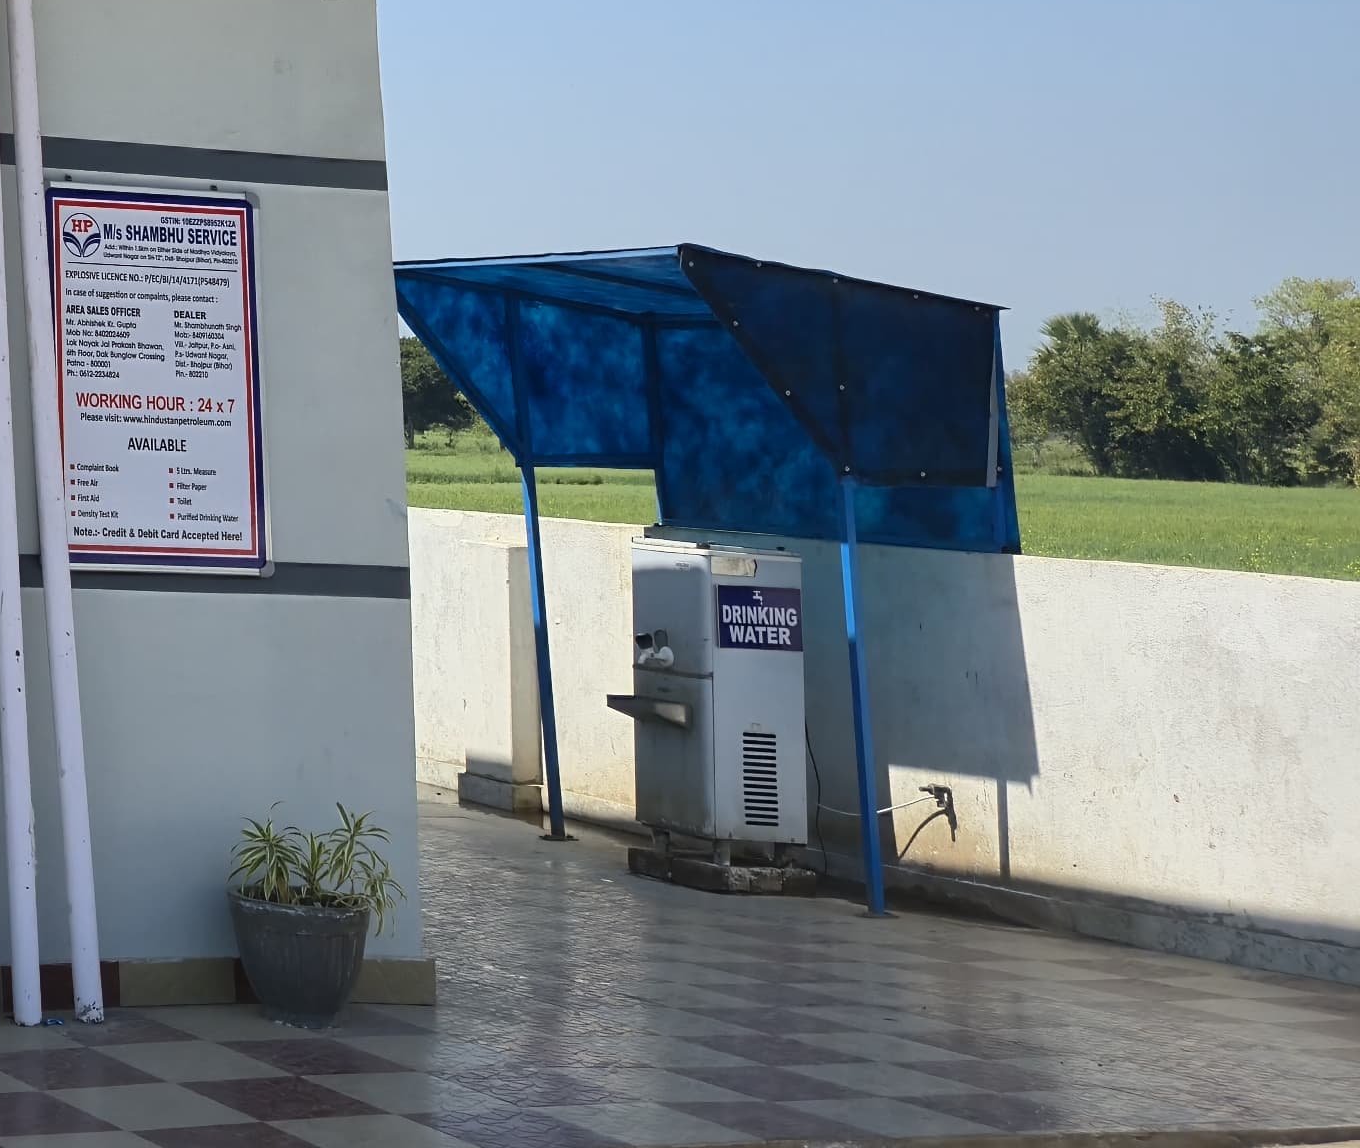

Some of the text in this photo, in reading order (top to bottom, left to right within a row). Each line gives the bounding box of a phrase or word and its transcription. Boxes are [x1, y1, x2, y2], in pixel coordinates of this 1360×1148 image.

[71, 219, 93, 233] HP
[103, 224, 237, 247] M/s SHAMBHU SERVICE
[66, 305, 141, 317] AREA SALES OFFICER
[174, 310, 207, 320] DEALER
[76, 392, 235, 414] WORKING HOUR 24 x 7
[80, 413, 232, 427] Please visit: www.hindustanpetroleum.com
[128, 437, 187, 452] AVAILABLE
[102, 528, 127, 538] Credit
[129, 529, 135, 538] &
[138, 529, 158, 539] Debit
[161, 529, 180, 540] Card
[182, 530, 219, 542] Accepted
[221, 530, 242, 541] Here!
[722, 604, 798, 627] DRINKING
[729, 625, 791, 645] WATER
